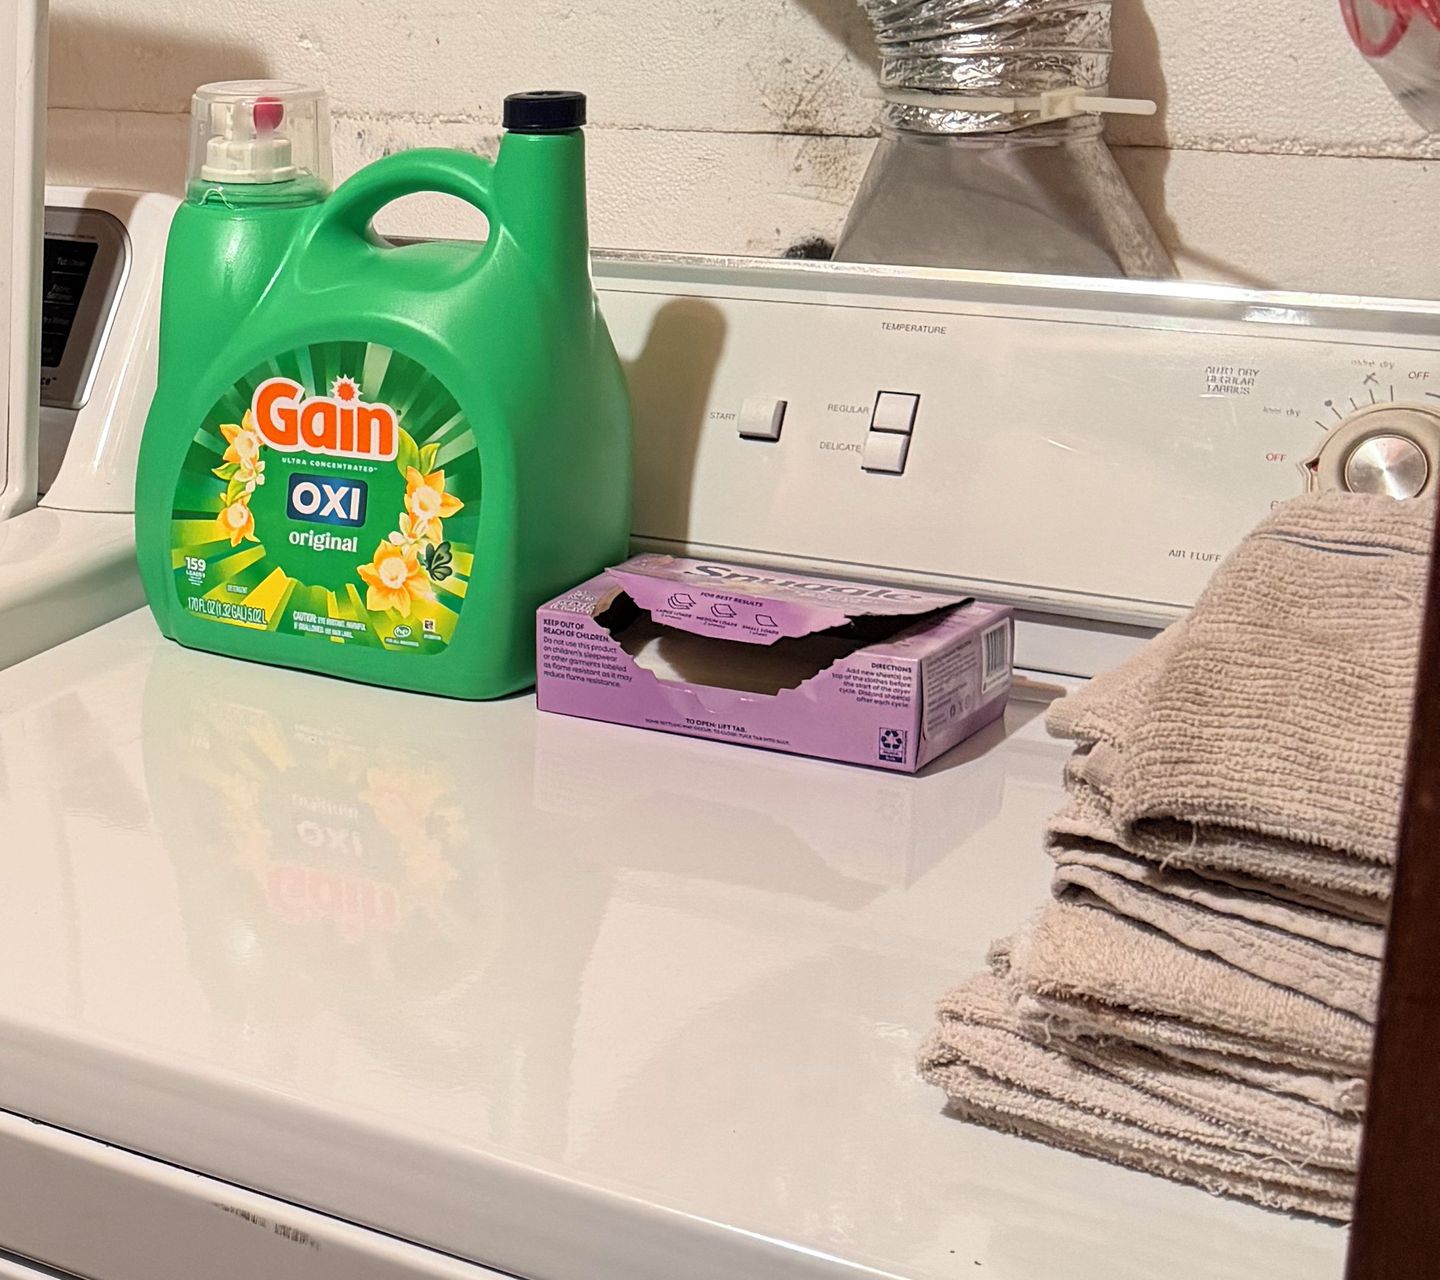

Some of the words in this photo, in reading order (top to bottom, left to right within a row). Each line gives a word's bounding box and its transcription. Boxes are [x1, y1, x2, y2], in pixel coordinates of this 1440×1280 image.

[881, 322, 947, 335] TEMPERATURE
[1408, 371, 1430, 380] OFF
[827, 404, 870, 414] REGULAR
[255, 376, 396, 459] Gain
[710, 412, 736, 421] START
[819, 441, 861, 453] DELICATE
[281, 457, 307, 466] ULTRA
[1266, 452, 1286, 462] OFF
[291, 481, 361, 522] OXI
[289, 530, 358, 554] original
[1168, 549, 1186, 558] AIR
[1190, 551, 1222, 562] FLUFF
[185, 556, 206, 572] 159
[684, 565, 922, 601] Snuggle
[188, 596, 199, 612] 170
[199, 598, 207, 613] FL
[207, 600, 216, 615] OZ
[715, 593, 733, 602] BEST
[734, 597, 764, 608] RESULTS
[560, 620, 574, 629] OUT
[543, 627, 565, 636] REACH
[543, 636, 552, 644] Do
[553, 638, 565, 646] not
[565, 640, 578, 648] use
[578, 641, 590, 650] this
[591, 644, 617, 654] product
[552, 646, 582, 658] children's
[584, 651, 617, 662] sleepwear
[551, 654, 568, 663] other
[569, 658, 601, 668] garments
[602, 662, 627, 672] labeled
[871, 662, 912, 673] DIRECTIONS
[543, 670, 565, 679] reduce
[565, 673, 585, 682] flame
[552, 662, 571, 671] flame
[572, 666, 601, 676] resistant
[617, 674, 633, 683] may
[864, 676, 888, 685] clothes
[889, 680, 911, 688] before
[858, 689, 883, 698] Discard
[873, 698, 891, 706] each
[717, 722, 731, 730] LIFT
